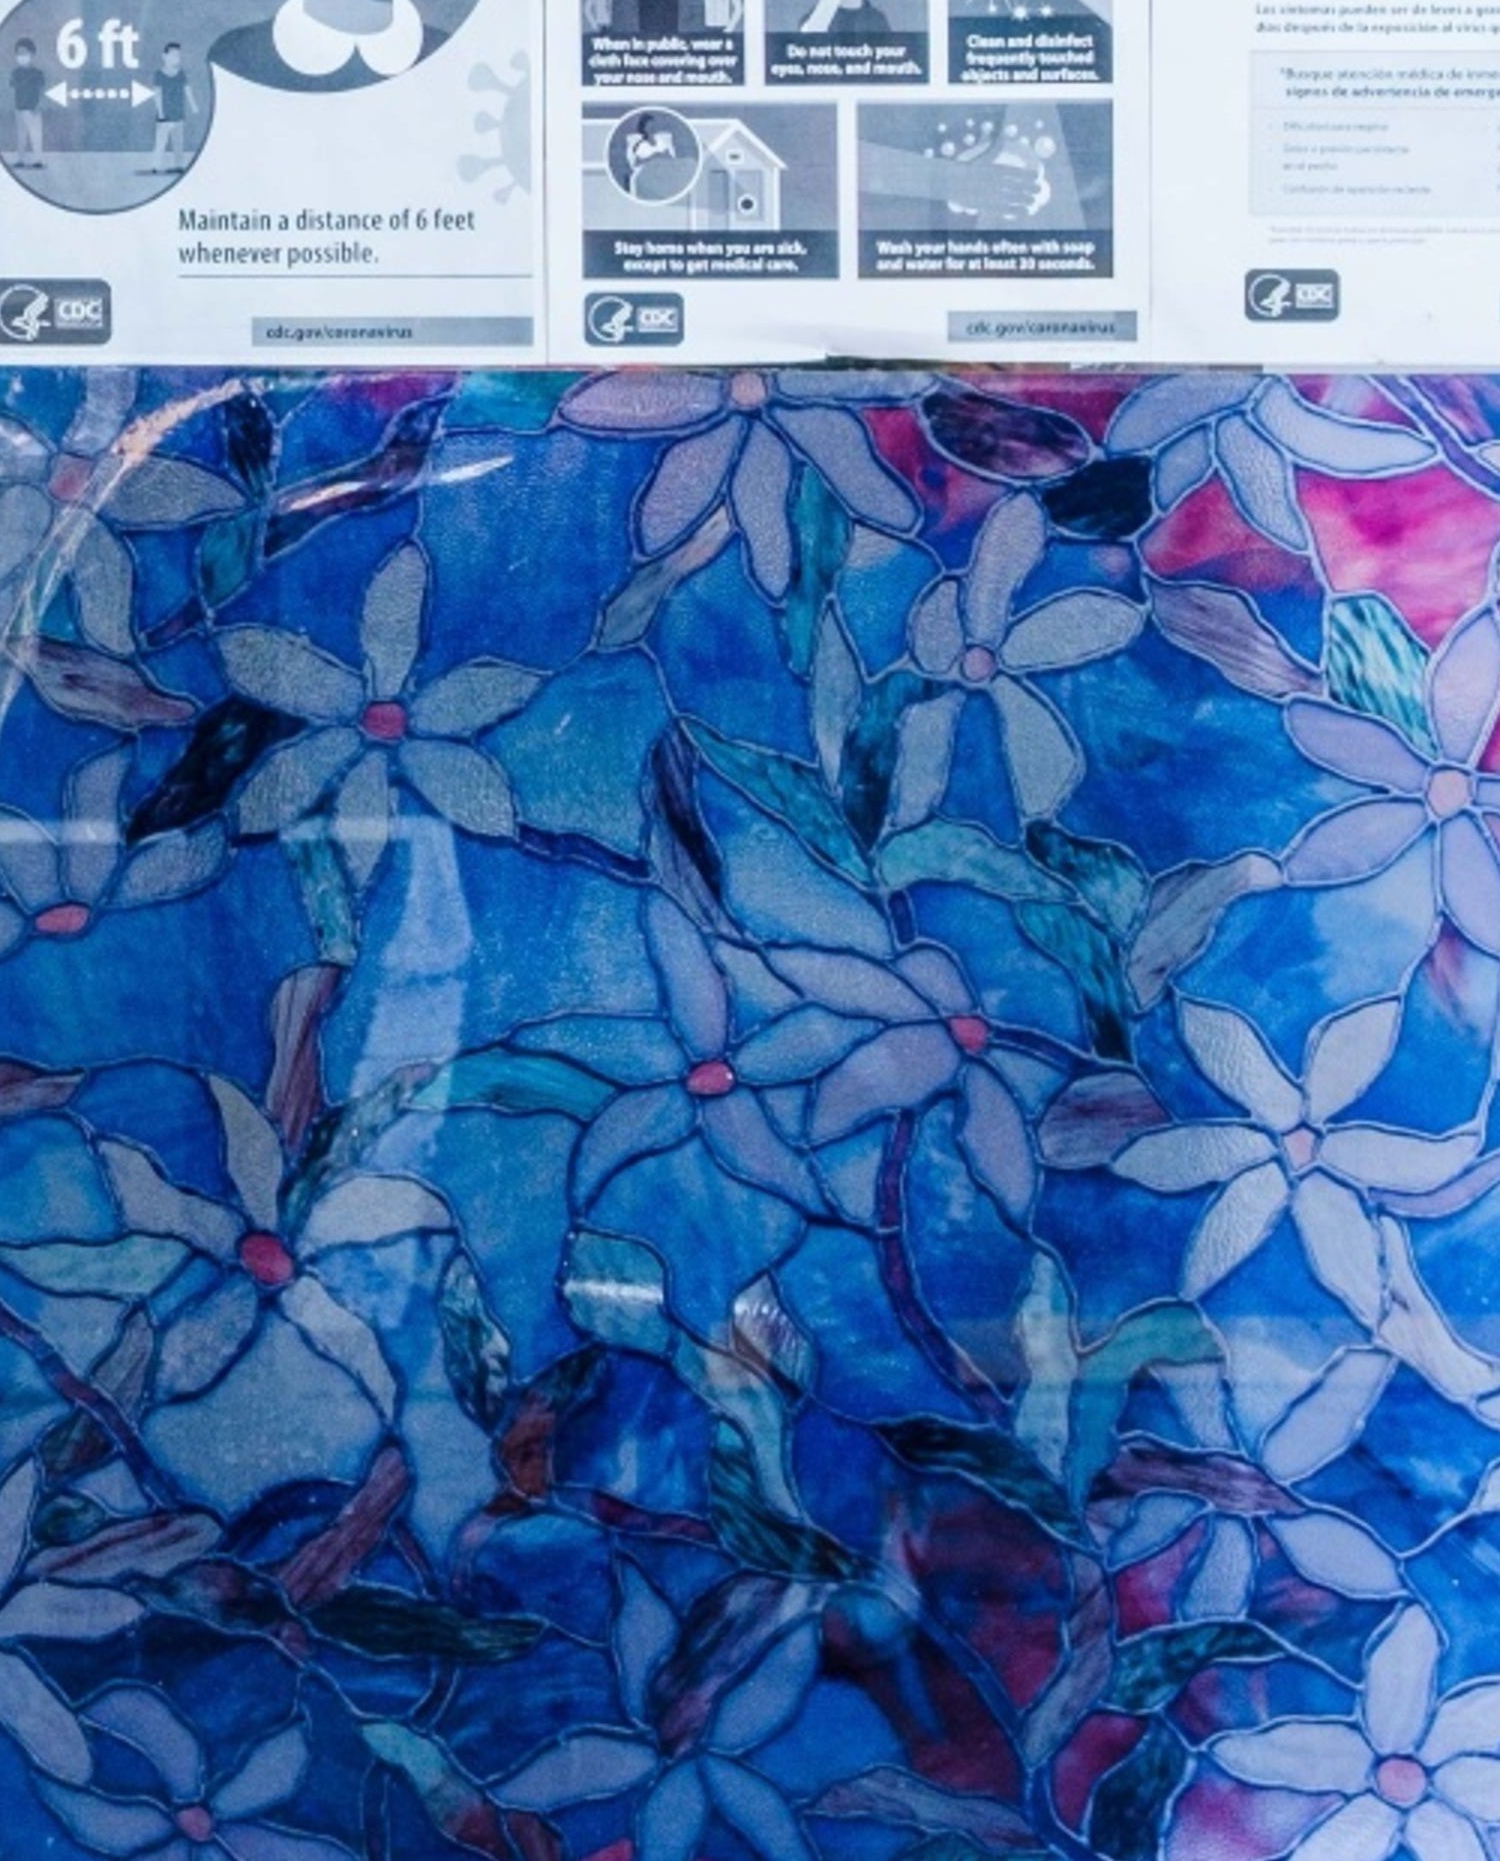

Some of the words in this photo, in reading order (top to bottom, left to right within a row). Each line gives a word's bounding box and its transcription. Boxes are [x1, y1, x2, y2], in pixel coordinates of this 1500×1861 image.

[56, 18, 88, 69] 6
[98, 18, 140, 69] ft
[178, 209, 272, 231] Maintain
[278, 214, 290, 231] a
[296, 208, 383, 231] distance
[388, 208, 410, 231] of
[416, 210, 428, 231] 6
[433, 208, 474, 231] feet
[178, 243, 281, 265] whenever
[287, 242, 379, 270] possible.
[57, 300, 100, 320] CDC
